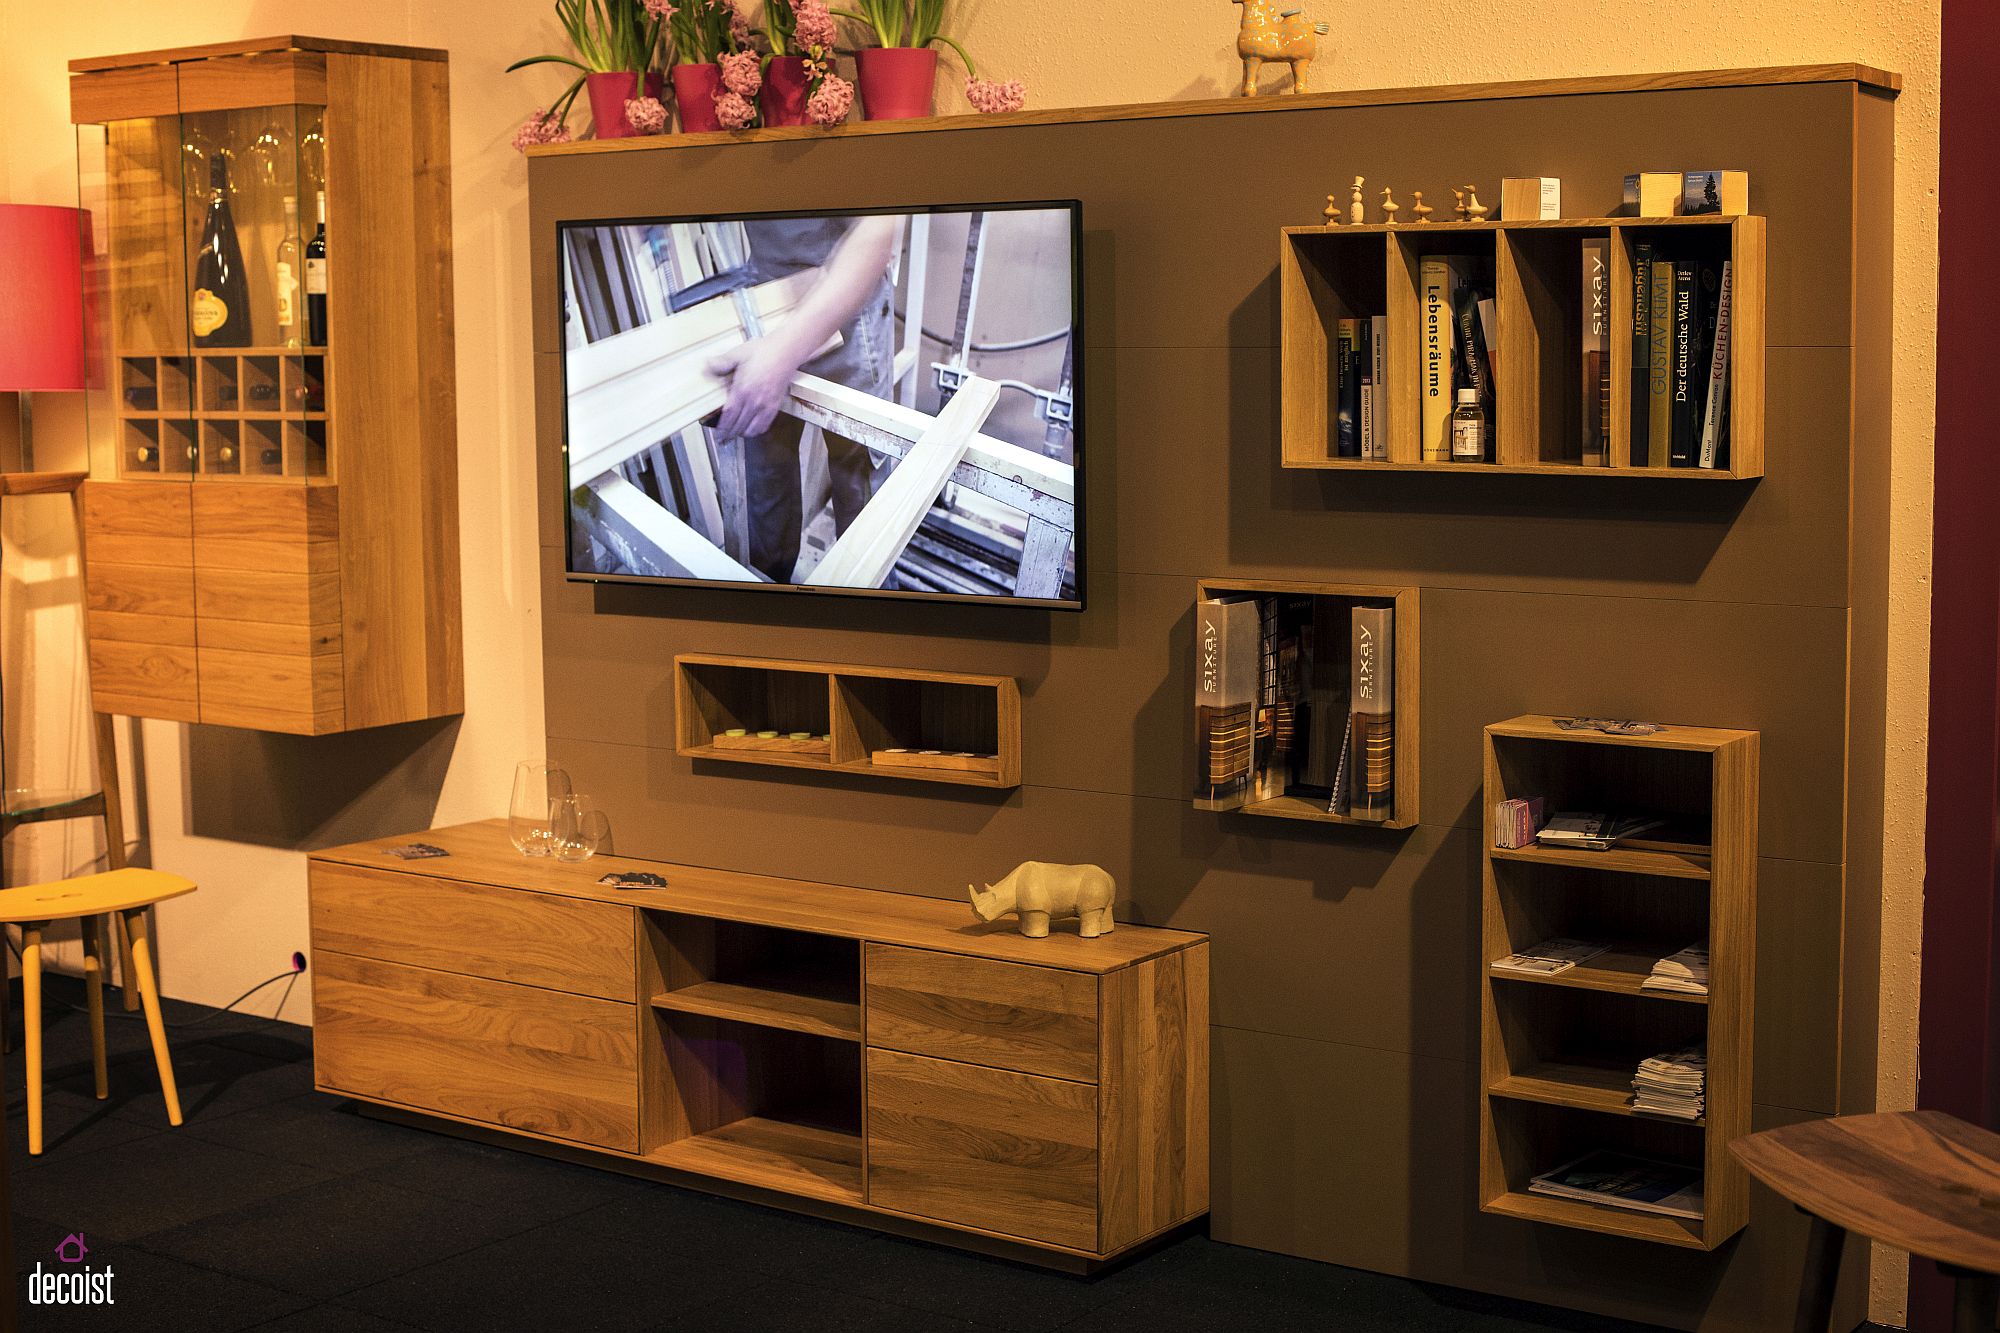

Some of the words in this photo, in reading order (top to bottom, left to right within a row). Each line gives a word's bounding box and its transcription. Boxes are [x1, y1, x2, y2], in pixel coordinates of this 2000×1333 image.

[1593, 256, 1605, 335] sixay
[1654, 273, 1669, 318] KLIMT
[1678, 290, 1689, 321] Wald
[1713, 268, 1732, 380] KÜCHEN-DESIGN
[1428, 286, 1441, 397] Lebensräume
[1651, 324, 1667, 395] GUSTAV
[1676, 323, 1688, 378] deutsche
[1676, 379, 1687, 402] Der
[1205, 620, 1216, 692] sixay
[1360, 624, 1371, 698] sixay
